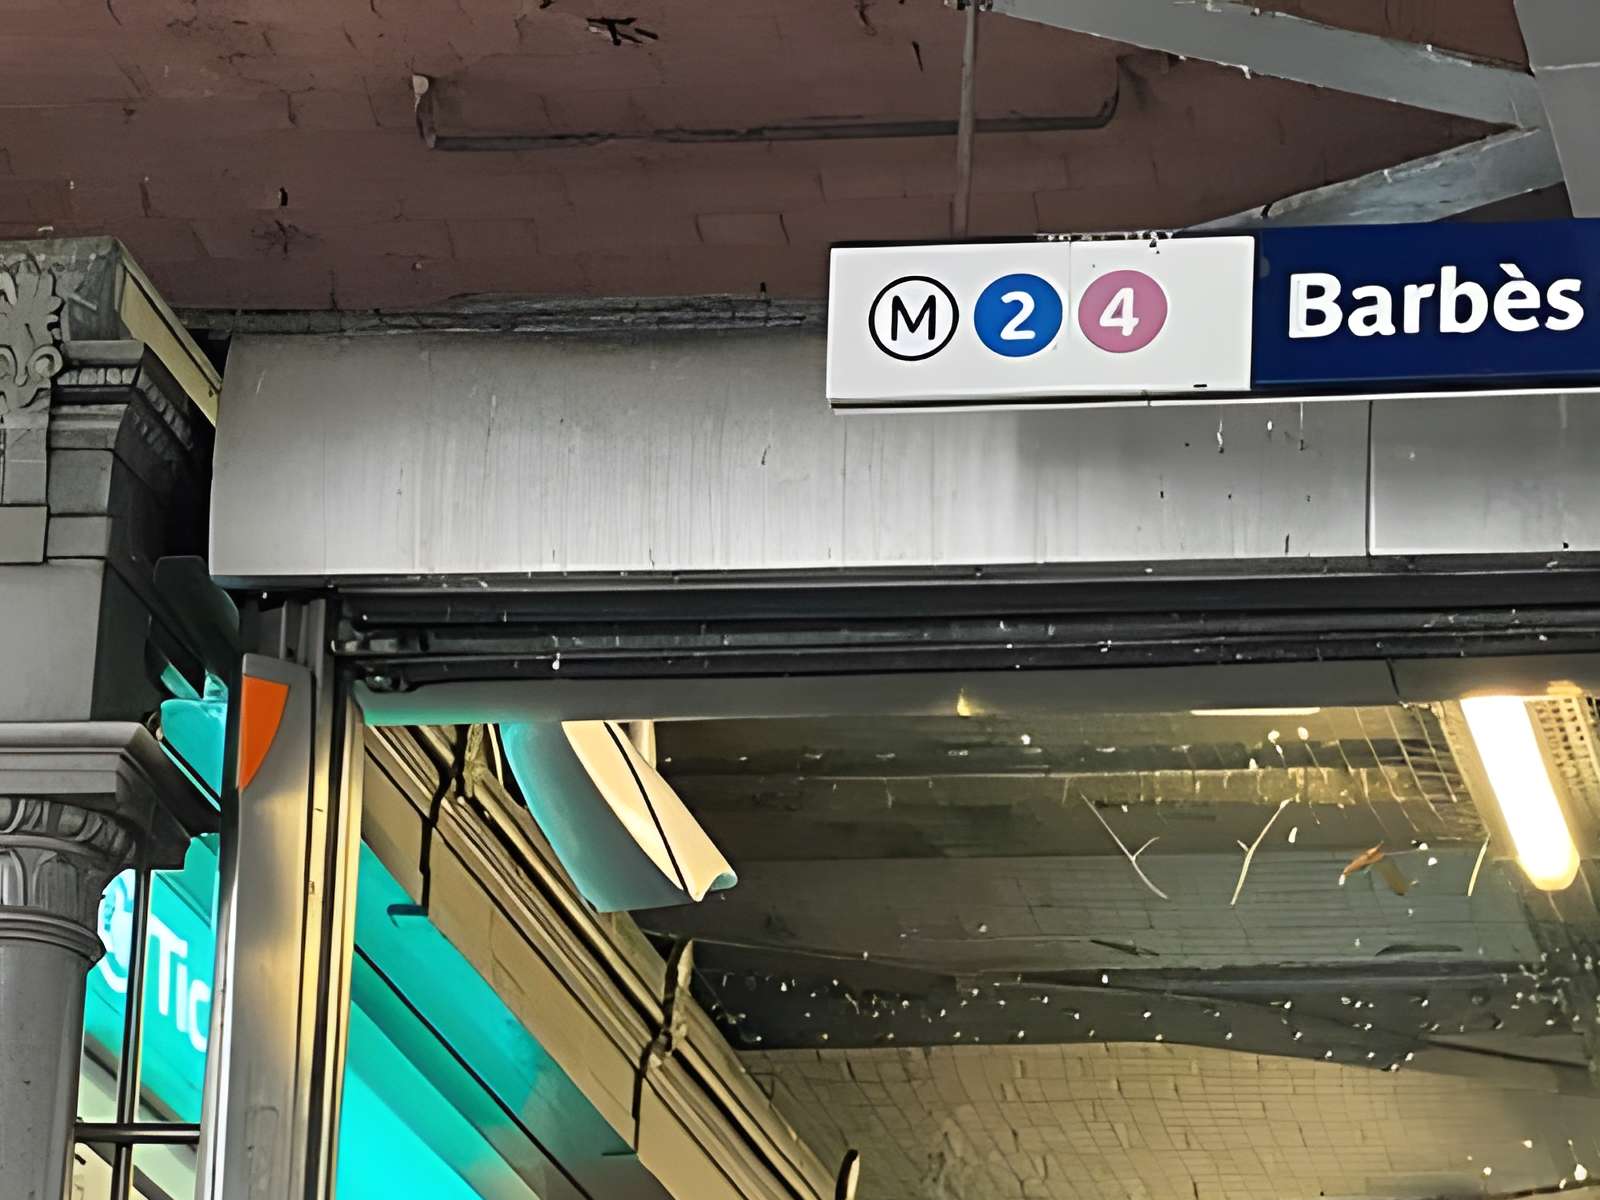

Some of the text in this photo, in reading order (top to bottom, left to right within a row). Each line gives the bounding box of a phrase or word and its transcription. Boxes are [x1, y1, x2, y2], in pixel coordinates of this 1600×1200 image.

[890, 286, 1140, 342] M 2 4
[1287, 262, 1586, 340] Barbès
